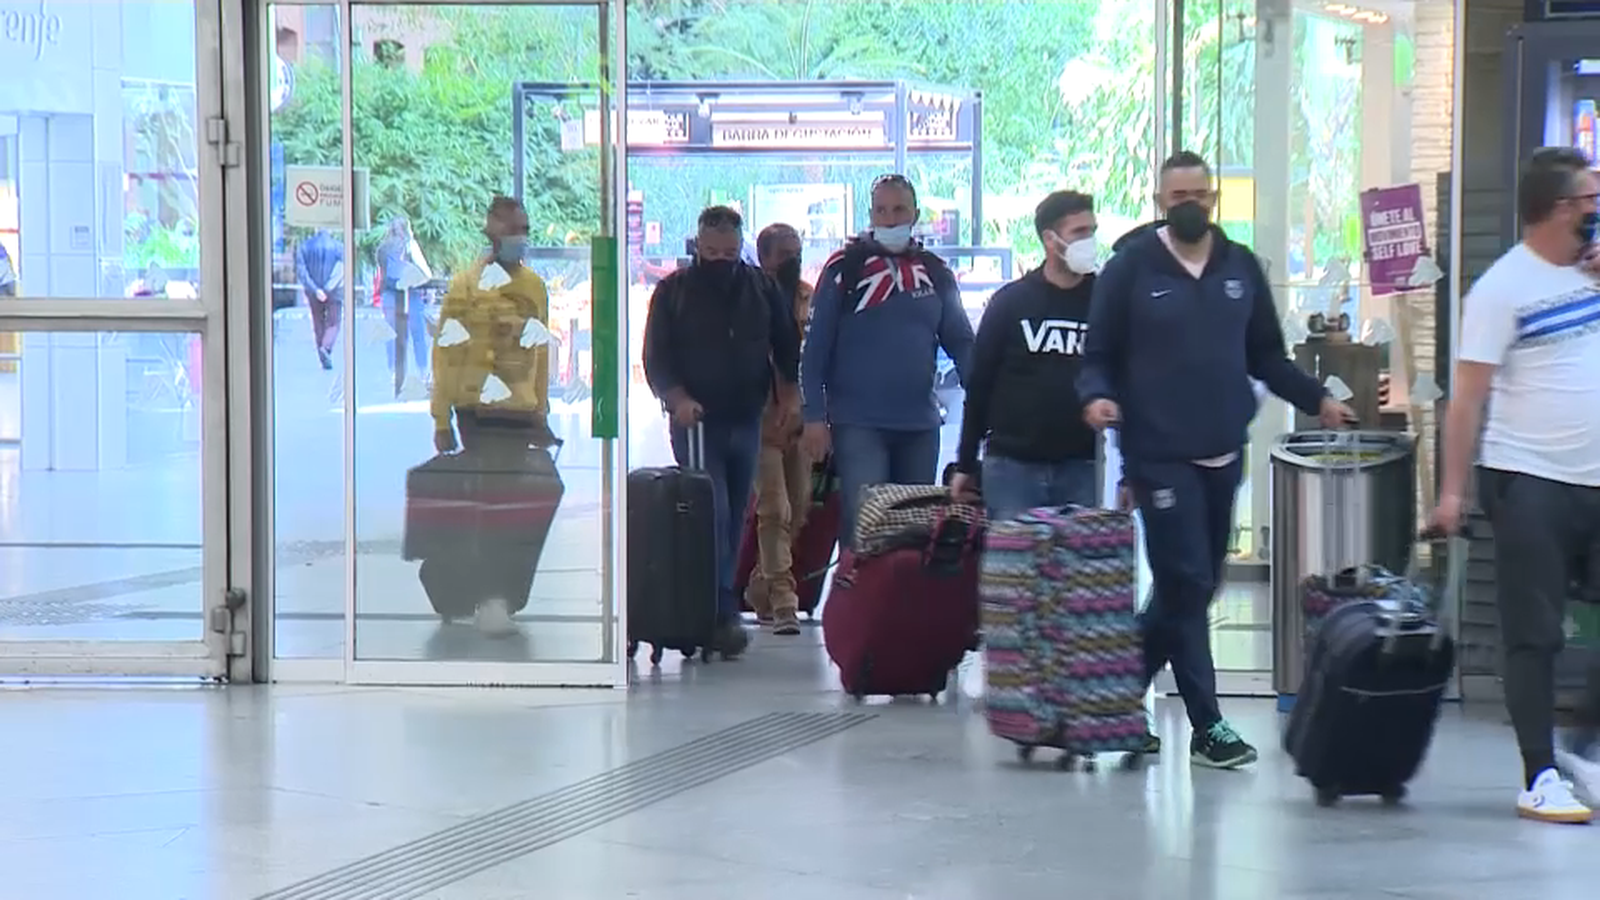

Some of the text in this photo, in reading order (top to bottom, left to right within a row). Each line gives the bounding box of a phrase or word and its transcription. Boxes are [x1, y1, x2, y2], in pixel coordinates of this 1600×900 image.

[0, 0, 61, 61] enfe
[722, 127, 770, 142] BARRA
[320, 199, 341, 207] FUM
[1372, 240, 1422, 260] SELF LOVE
[1021, 319, 1088, 355] VAN
